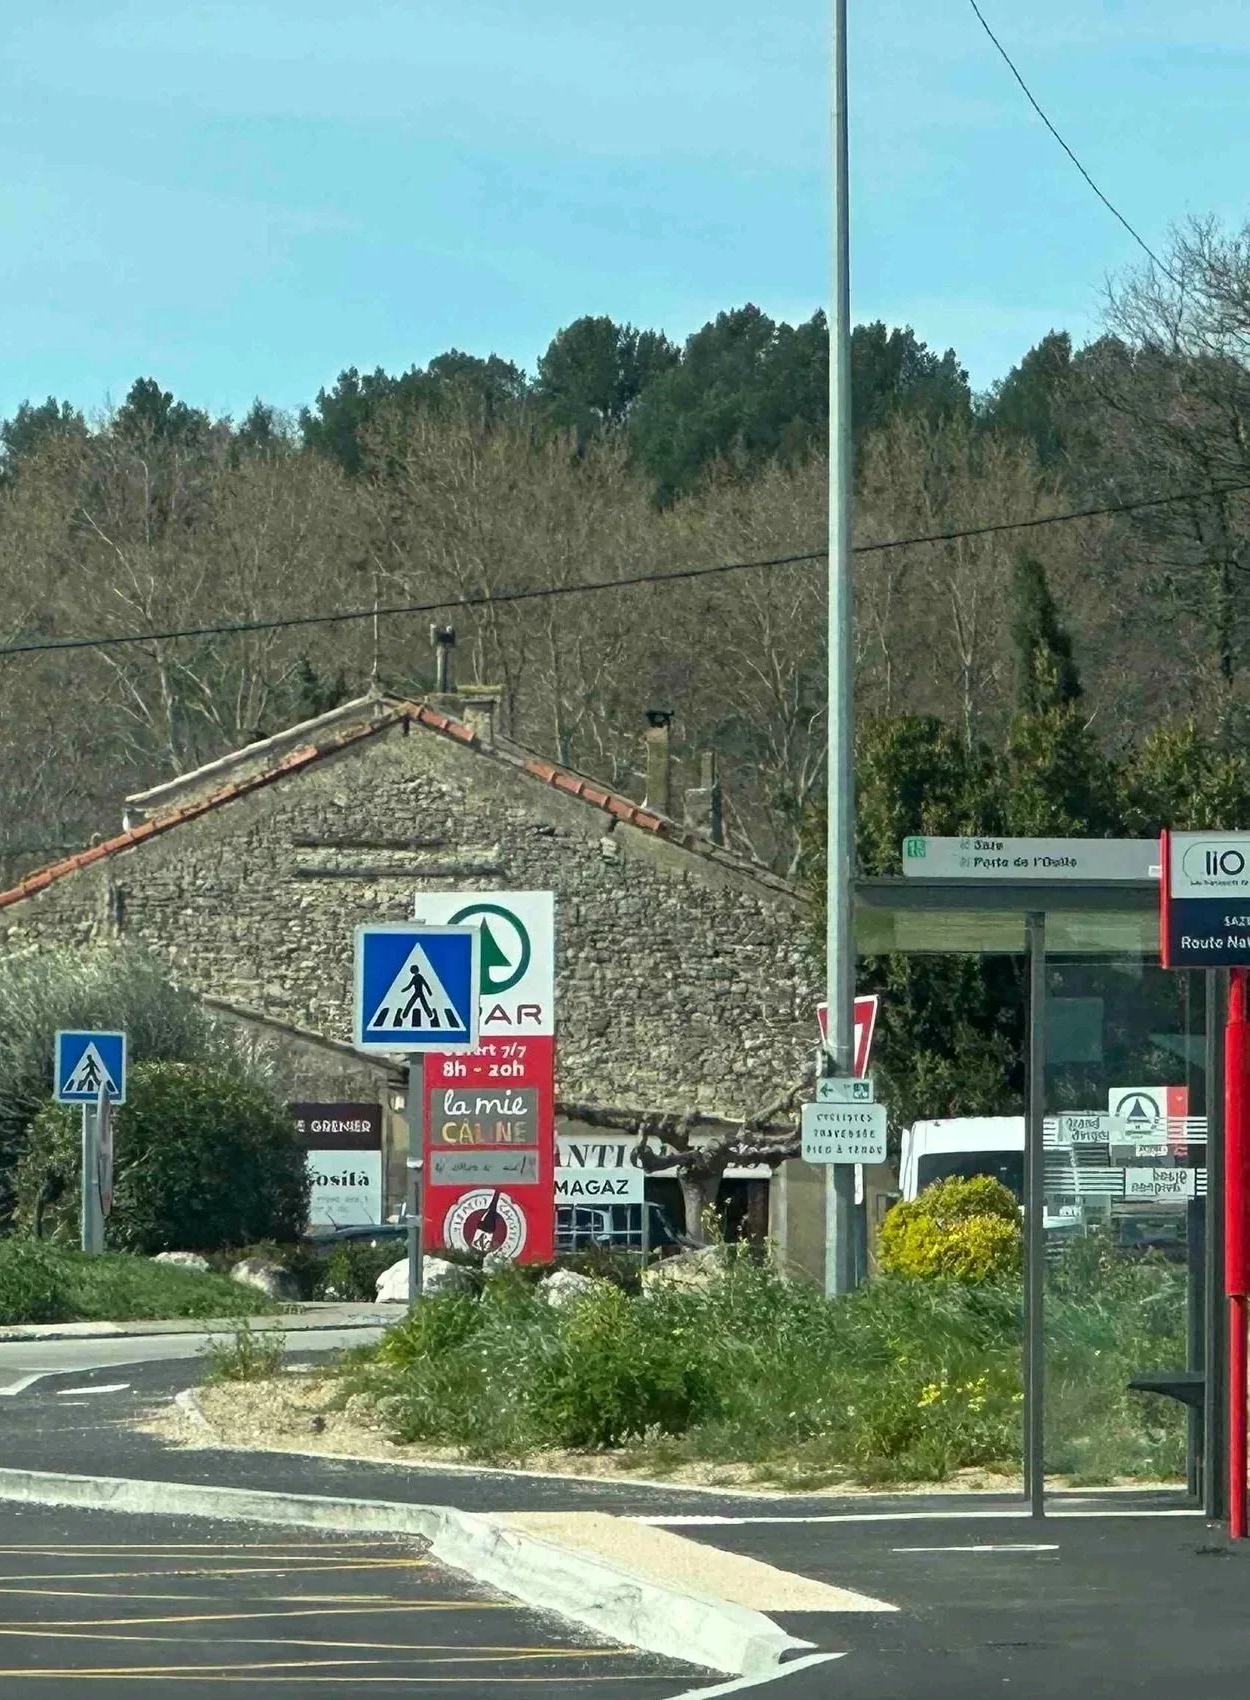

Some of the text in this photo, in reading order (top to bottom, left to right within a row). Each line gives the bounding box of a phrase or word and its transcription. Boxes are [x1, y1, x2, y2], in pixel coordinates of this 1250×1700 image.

[1181, 935, 1224, 949] Route
[479, 1003, 542, 1026] AR
[500, 1042, 527, 1059] 7/7
[442, 1060, 467, 1078] 8h
[488, 1060, 525, 1078] 20h
[443, 1088, 528, 1116] la mie
